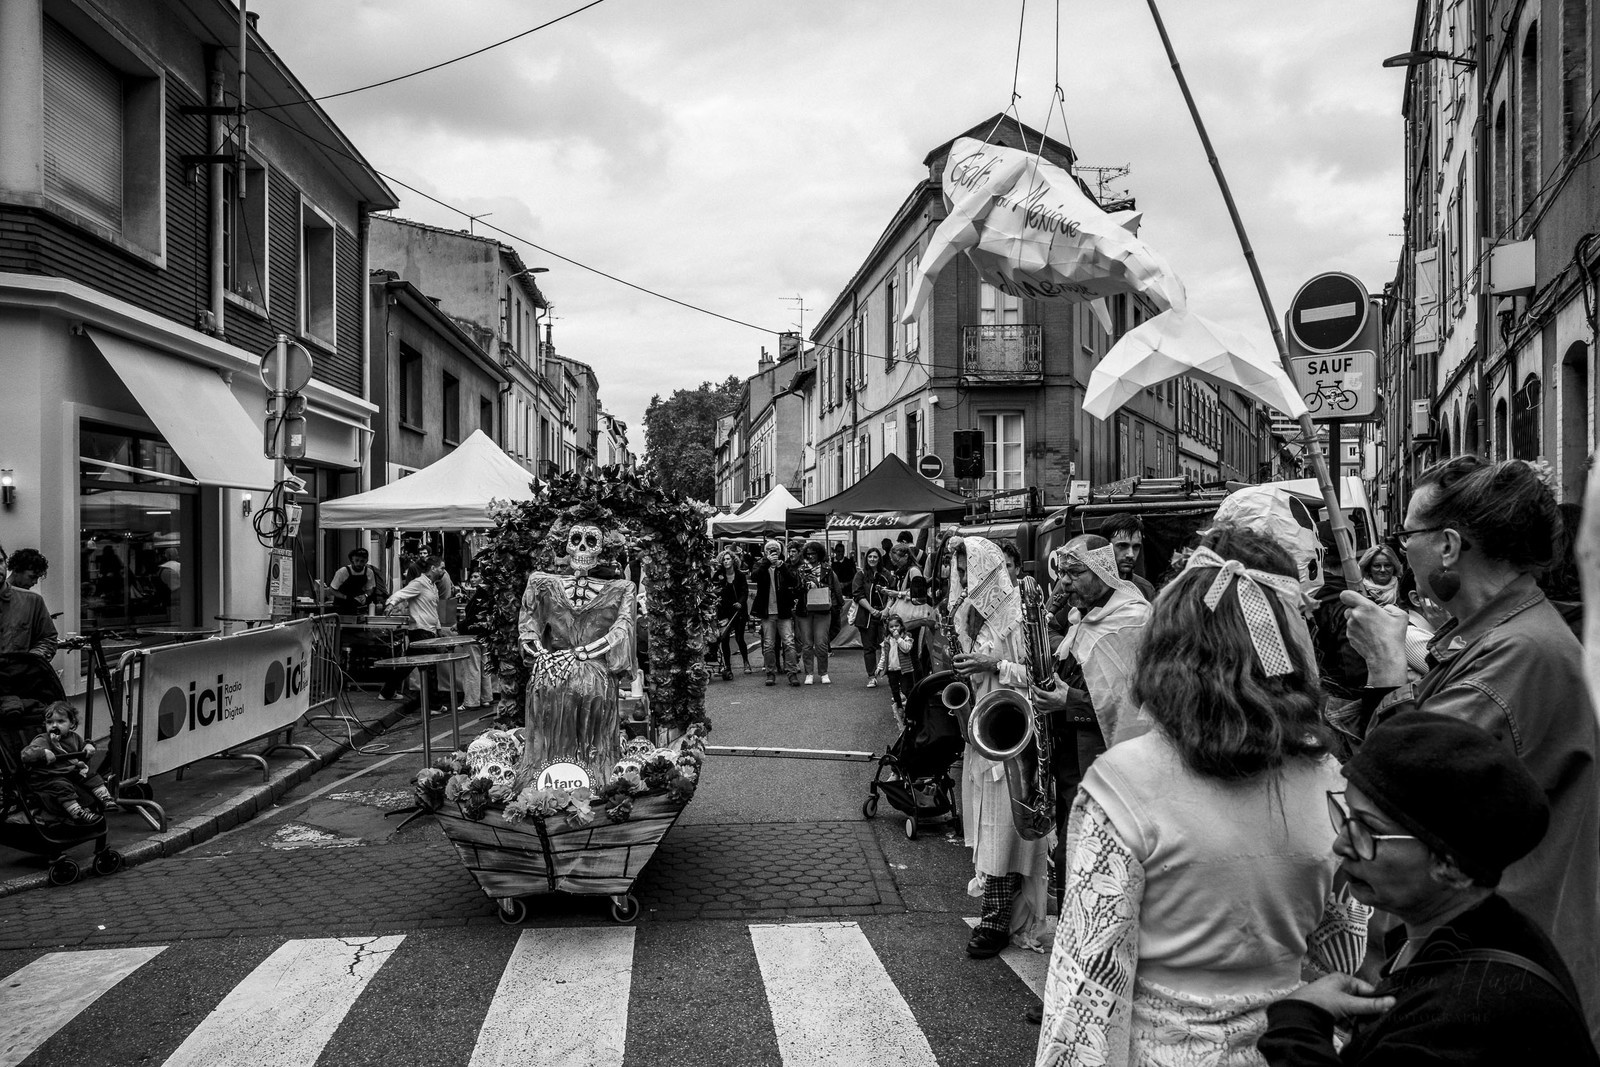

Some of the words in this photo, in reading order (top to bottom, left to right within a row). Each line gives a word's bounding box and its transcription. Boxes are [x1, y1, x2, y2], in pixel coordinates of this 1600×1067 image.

[1012, 180, 1080, 250] Mexique
[1308, 357, 1353, 375] SAUF
[826, 514, 884, 530] falafel
[885, 516, 900, 526] 31
[286, 652, 304, 699] ici
[225, 681, 242, 694] Radio
[189, 674, 223, 731] ici
[225, 696, 234, 706] TV
[225, 706, 245, 721] Digital
